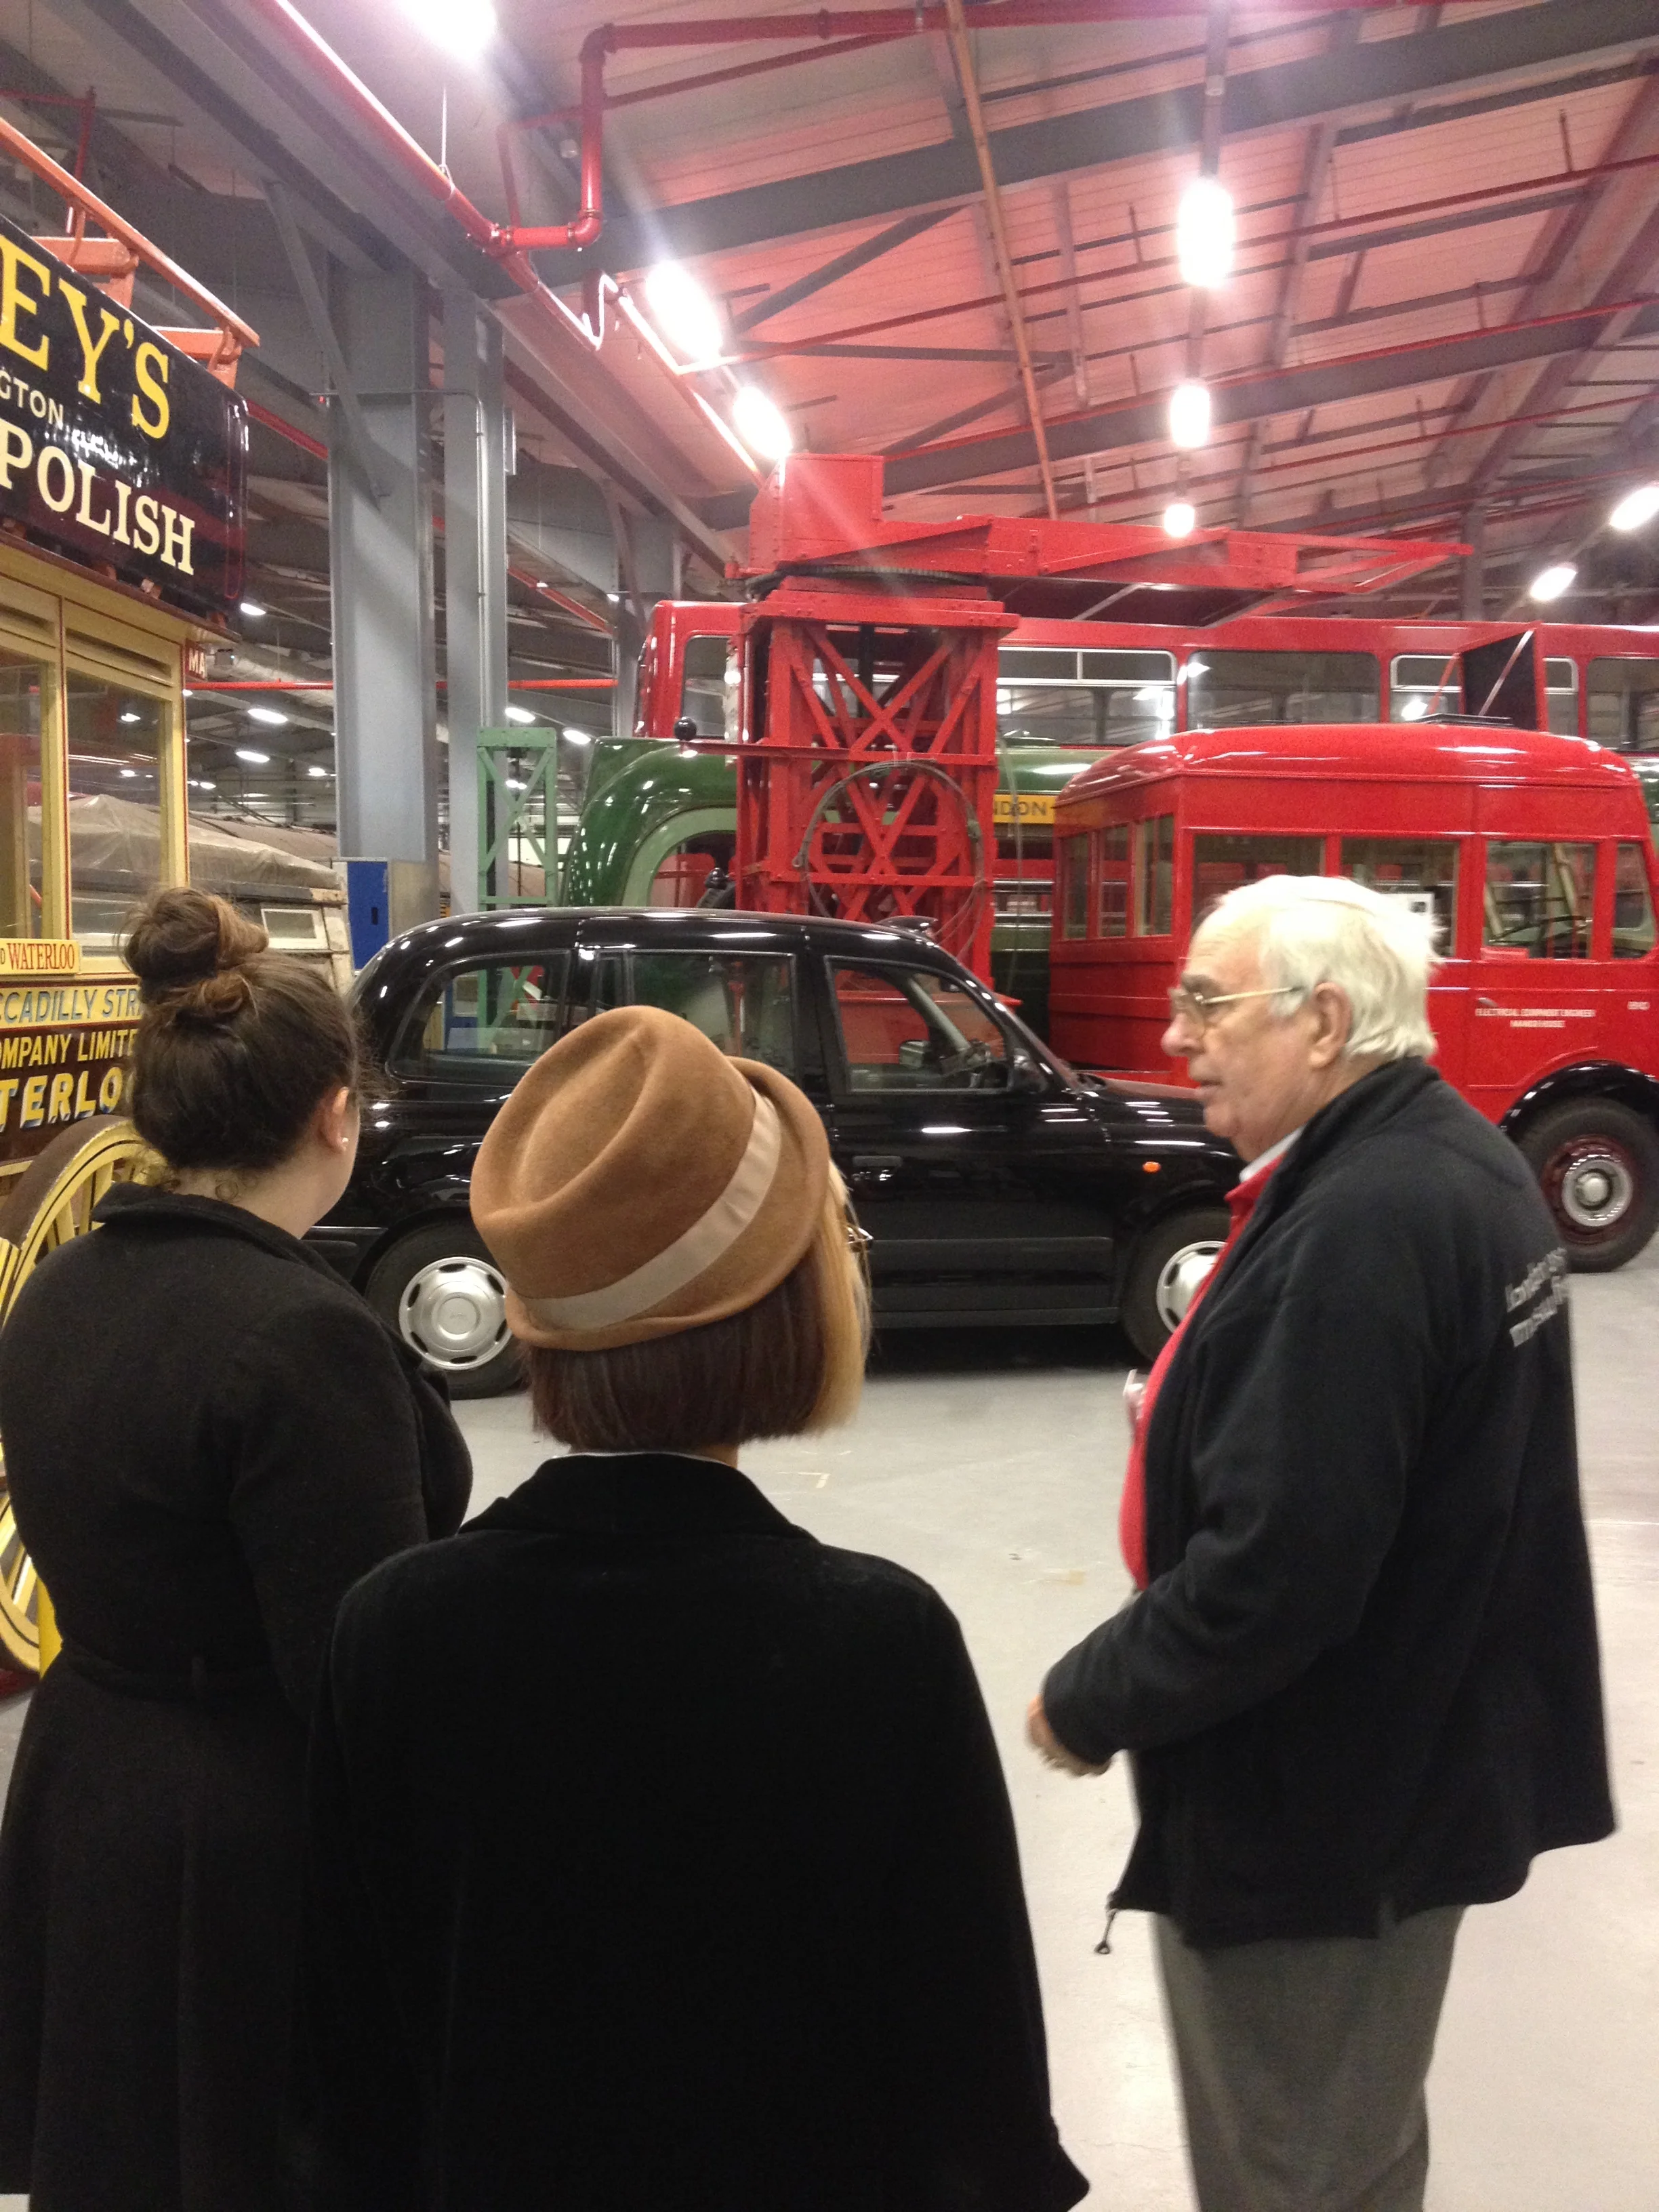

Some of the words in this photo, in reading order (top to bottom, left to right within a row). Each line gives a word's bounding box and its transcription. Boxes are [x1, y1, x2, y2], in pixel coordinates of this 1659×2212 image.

[0, 234, 169, 439] EY'S
[0, 417, 194, 575] POLISH
[189, 647, 206, 678] MA
[994, 801, 1047, 815] DON
[7, 943, 75, 970] WATERLOO
[0, 989, 98, 1024] CADILLY
[102, 988, 140, 1018] STR
[0, 1033, 72, 1069] MPANY
[0, 1065, 135, 1132] TERLO
